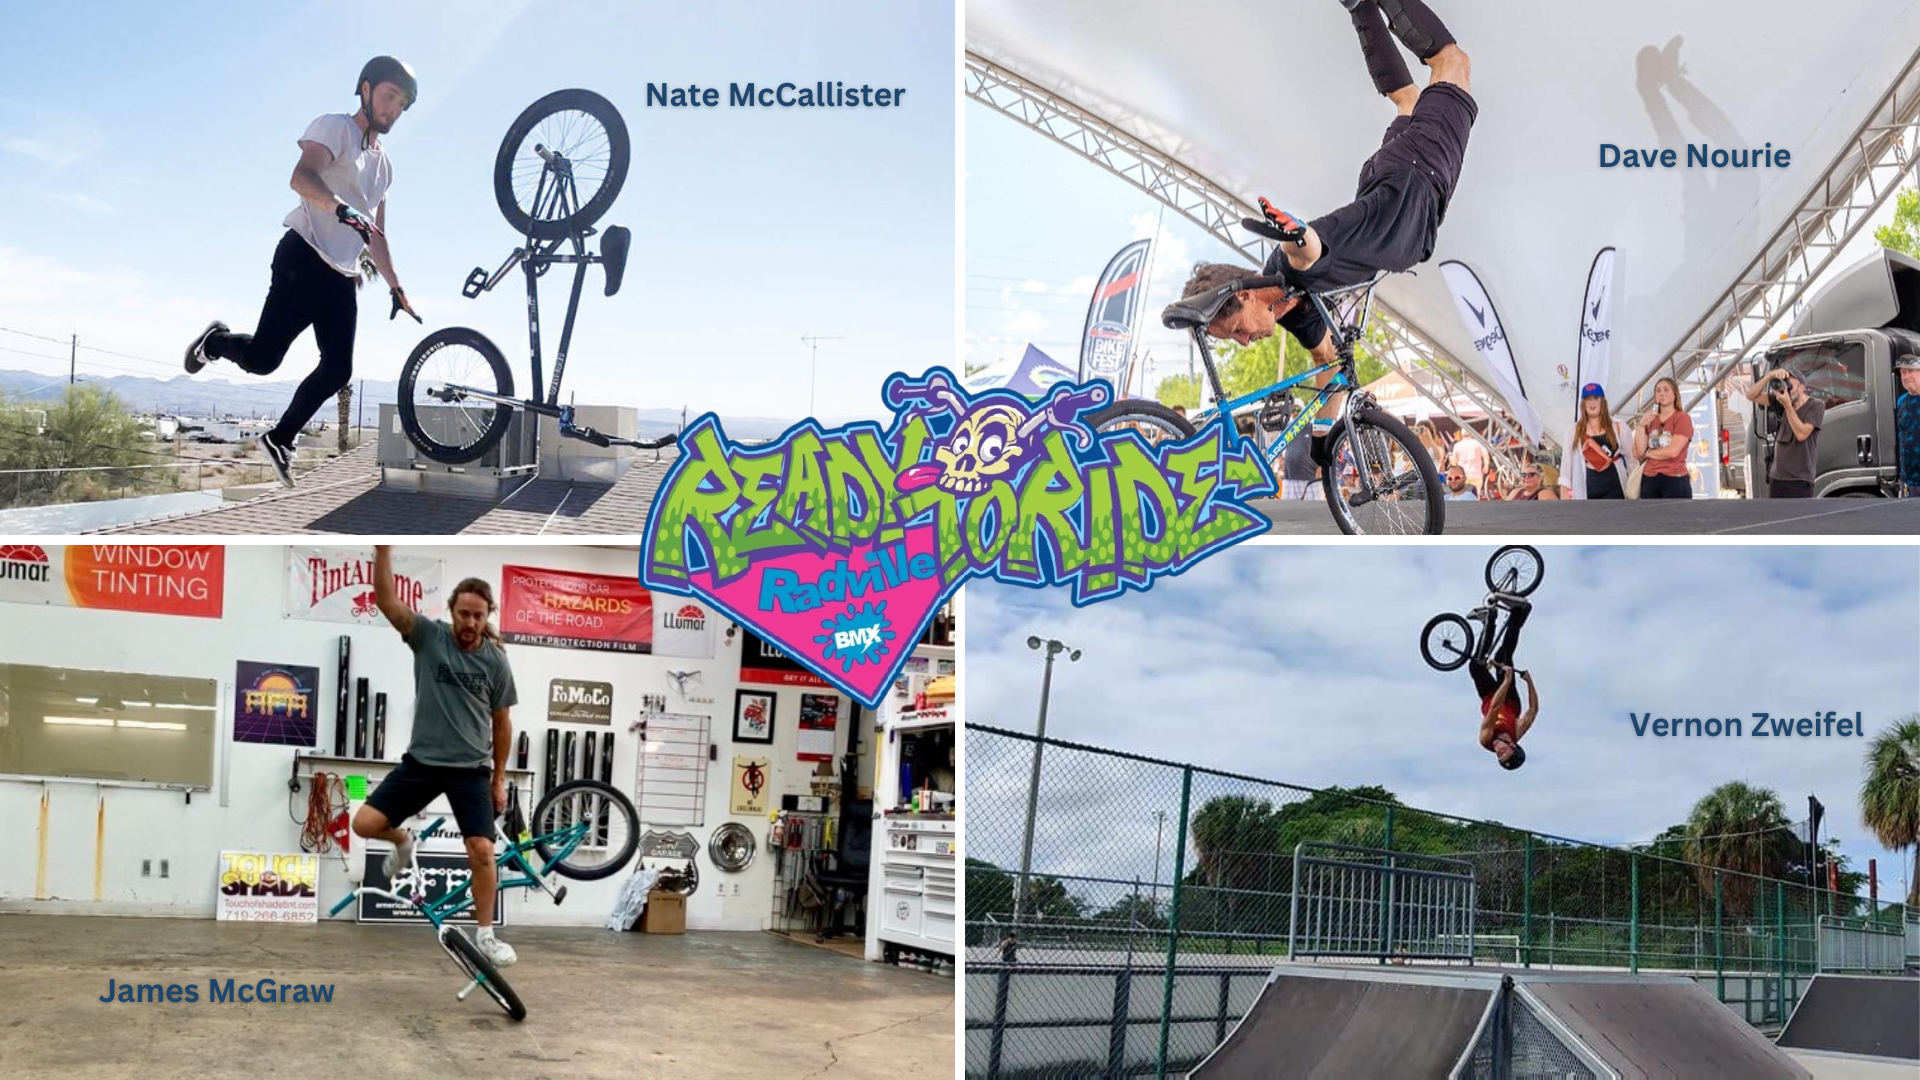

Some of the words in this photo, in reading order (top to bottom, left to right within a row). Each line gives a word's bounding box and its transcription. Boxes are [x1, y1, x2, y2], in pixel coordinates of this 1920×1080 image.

[1094, 339, 1124, 355] BIKE
[1092, 353, 1121, 371] FEST
[92, 545, 209, 571] WINDOW
[91, 569, 208, 600] TINTING
[589, 583, 610, 594] CAR
[543, 592, 632, 615] HAZARDS
[515, 609, 533, 623] OF
[538, 612, 563, 626] THE
[663, 612, 705, 631] LLumar
[514, 633, 544, 644] PAINT
[547, 636, 610, 649] PROTECTION
[613, 640, 637, 651] FILM
[551, 684, 611, 706] FoMoCo
[222, 853, 317, 874] TOUCH
[220, 871, 316, 898] SHADE
